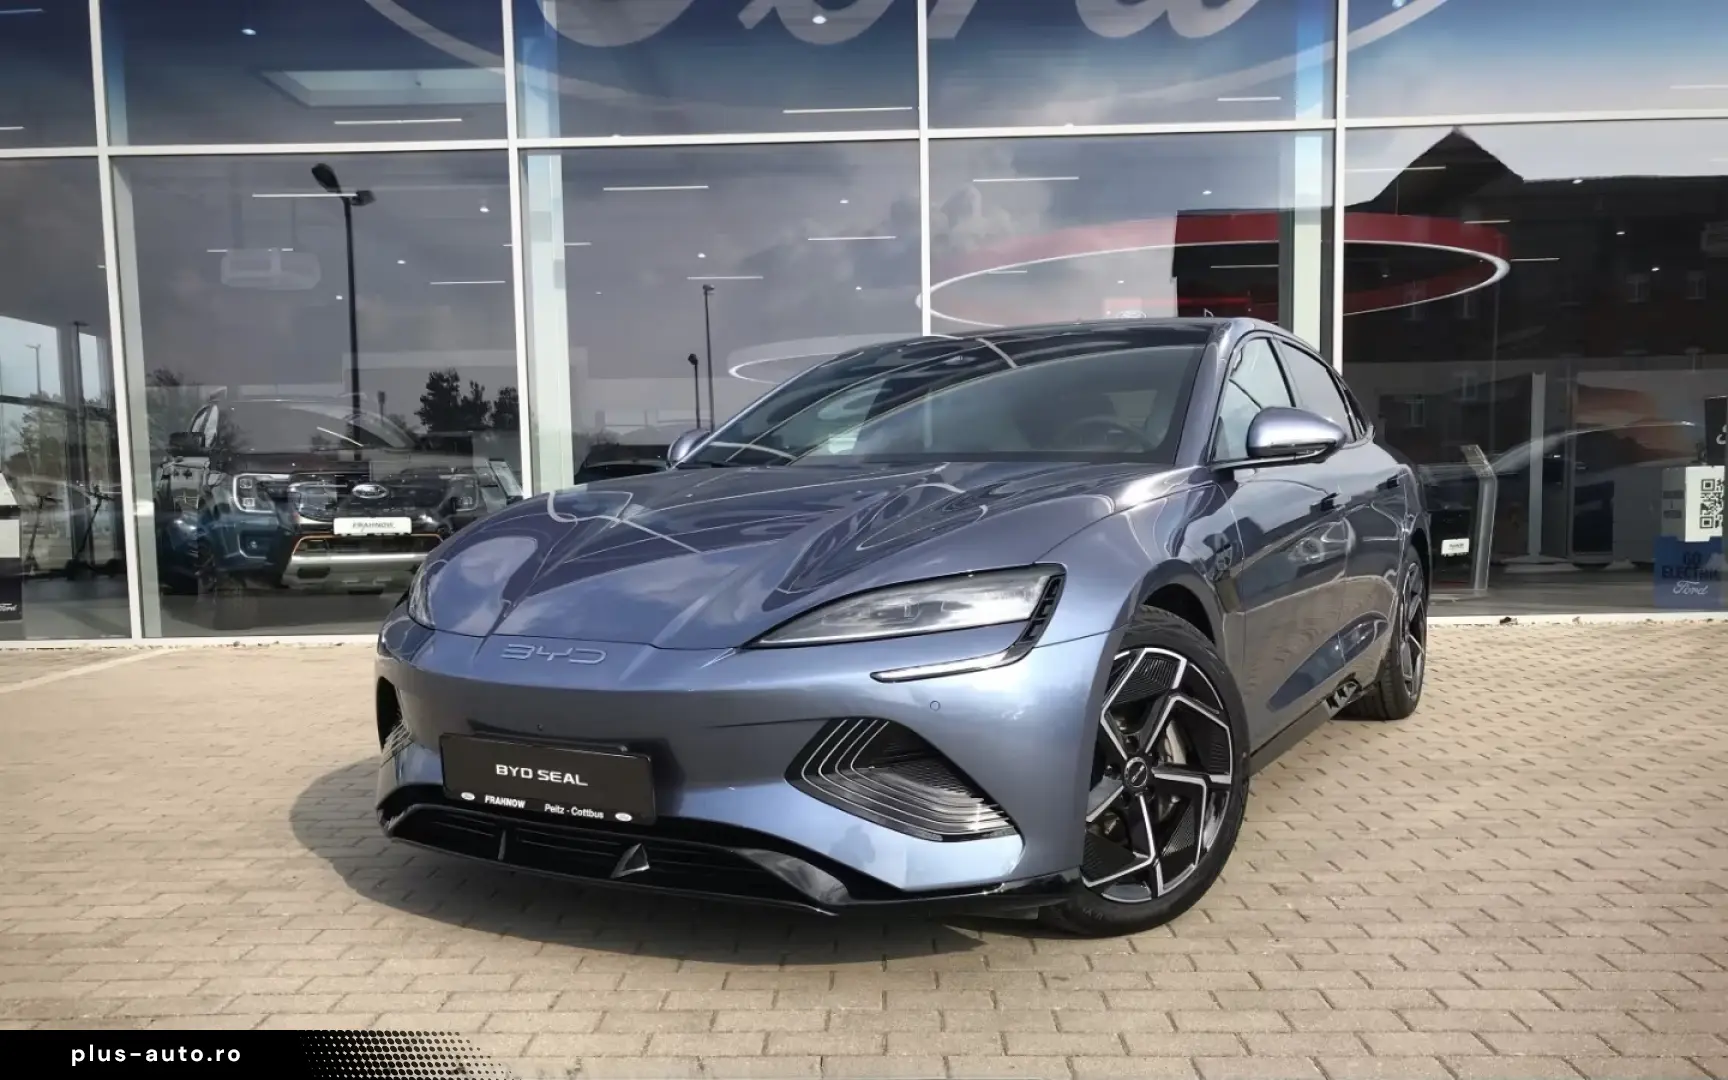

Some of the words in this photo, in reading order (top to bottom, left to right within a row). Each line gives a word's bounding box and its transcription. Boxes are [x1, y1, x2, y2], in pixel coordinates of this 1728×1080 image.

[1672, 580, 1709, 595] Ford
[501, 643, 606, 664] BYD
[495, 763, 534, 780] BYD
[537, 769, 589, 787] SEAL
[484, 794, 526, 809] FRAHNOW
[544, 803, 565, 815] Peitz
[571, 806, 604, 819] Cottbus
